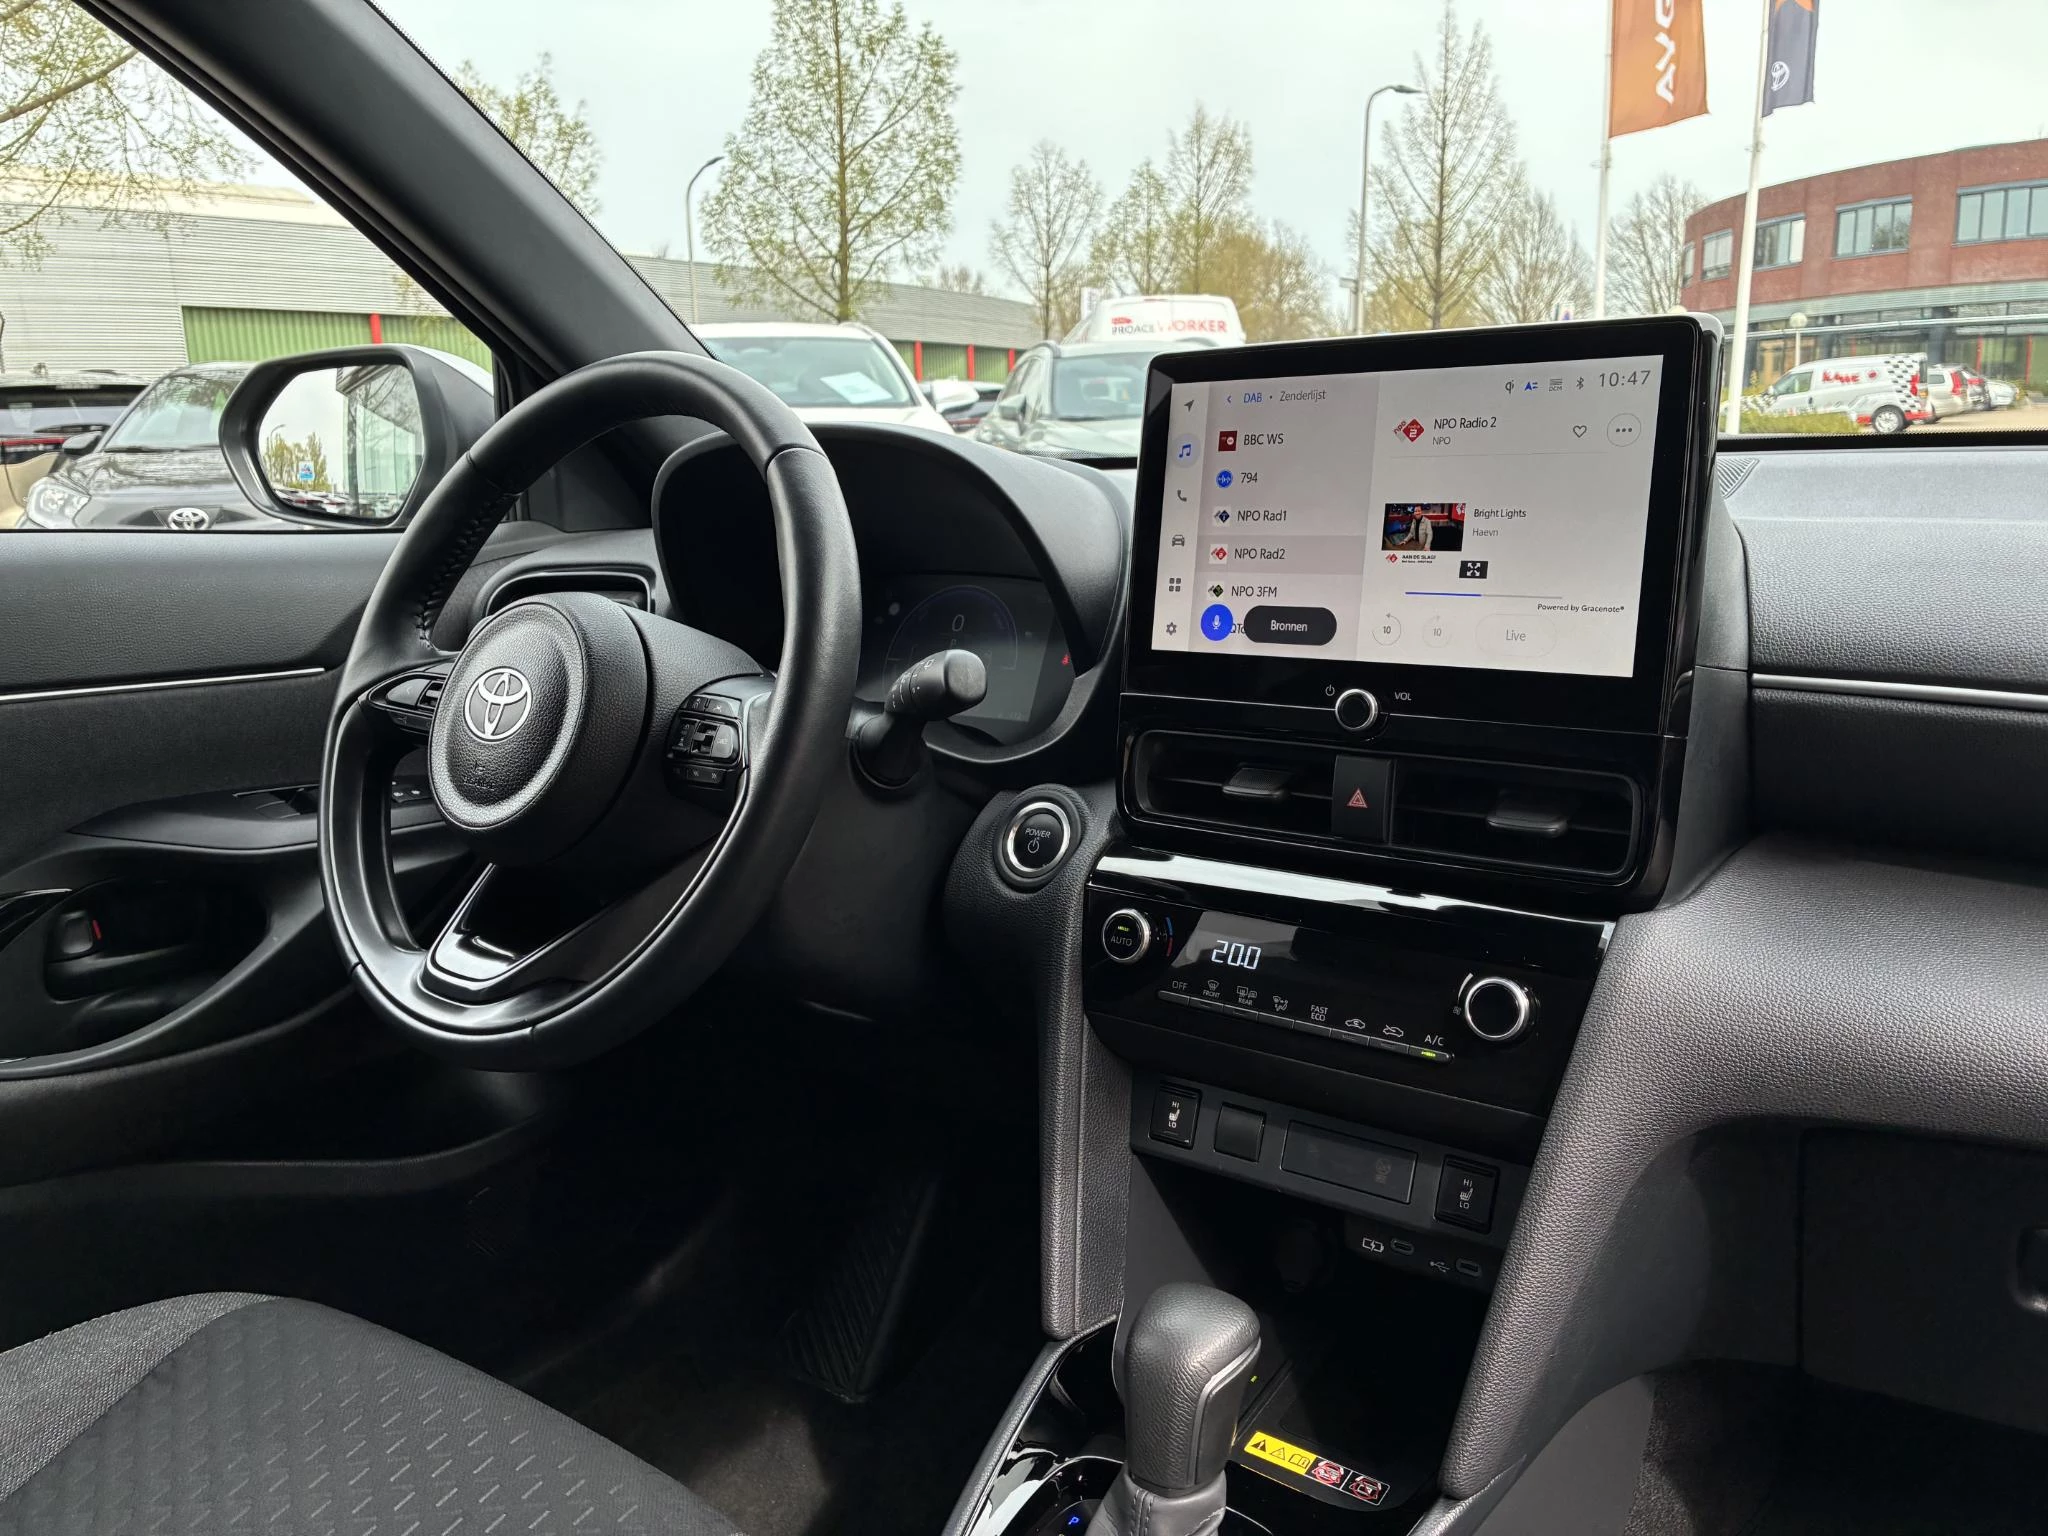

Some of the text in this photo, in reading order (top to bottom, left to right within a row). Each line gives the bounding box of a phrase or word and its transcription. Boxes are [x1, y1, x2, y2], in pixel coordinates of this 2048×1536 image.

[1600, 370, 1651, 387] 10:47
[1244, 390, 1326, 404] DAB Zenderlijst
[1434, 416, 1497, 430] NPO Radio 2
[1244, 433, 1284, 446] BBC WS
[1432, 436, 1451, 446] NPO
[1240, 472, 1258, 484] 794
[1237, 510, 1287, 522] NPO Rad1
[1474, 508, 1526, 520] Bright Lights
[1472, 528, 1498, 537] Haevn
[1234, 548, 1286, 560] NPO Rad2
[1231, 586, 1278, 598] NPO 3FM
[1537, 603, 1569, 612] Powered
[1570, 604, 1580, 613] by
[952, 614, 965, 632] 0
[1270, 620, 1308, 632] Bronnen
[1383, 626, 1392, 634] 10
[1433, 628, 1442, 636] 10
[1506, 629, 1526, 642] Live
[1394, 692, 1412, 700] VOL
[1025, 828, 1051, 838] POWER
[1110, 936, 1132, 947] AUTO
[1211, 940, 1262, 970] 20.0
[1172, 980, 1188, 991] OFF
[1203, 990, 1220, 998] FRONT
[1238, 998, 1253, 1006] REAR
[1311, 1005, 1328, 1015] FAST
[1310, 1012, 1326, 1022] ECO
[1424, 1034, 1444, 1046] A/C
[1464, 1178, 1472, 1187] HI
[1460, 1200, 1470, 1209] LO
